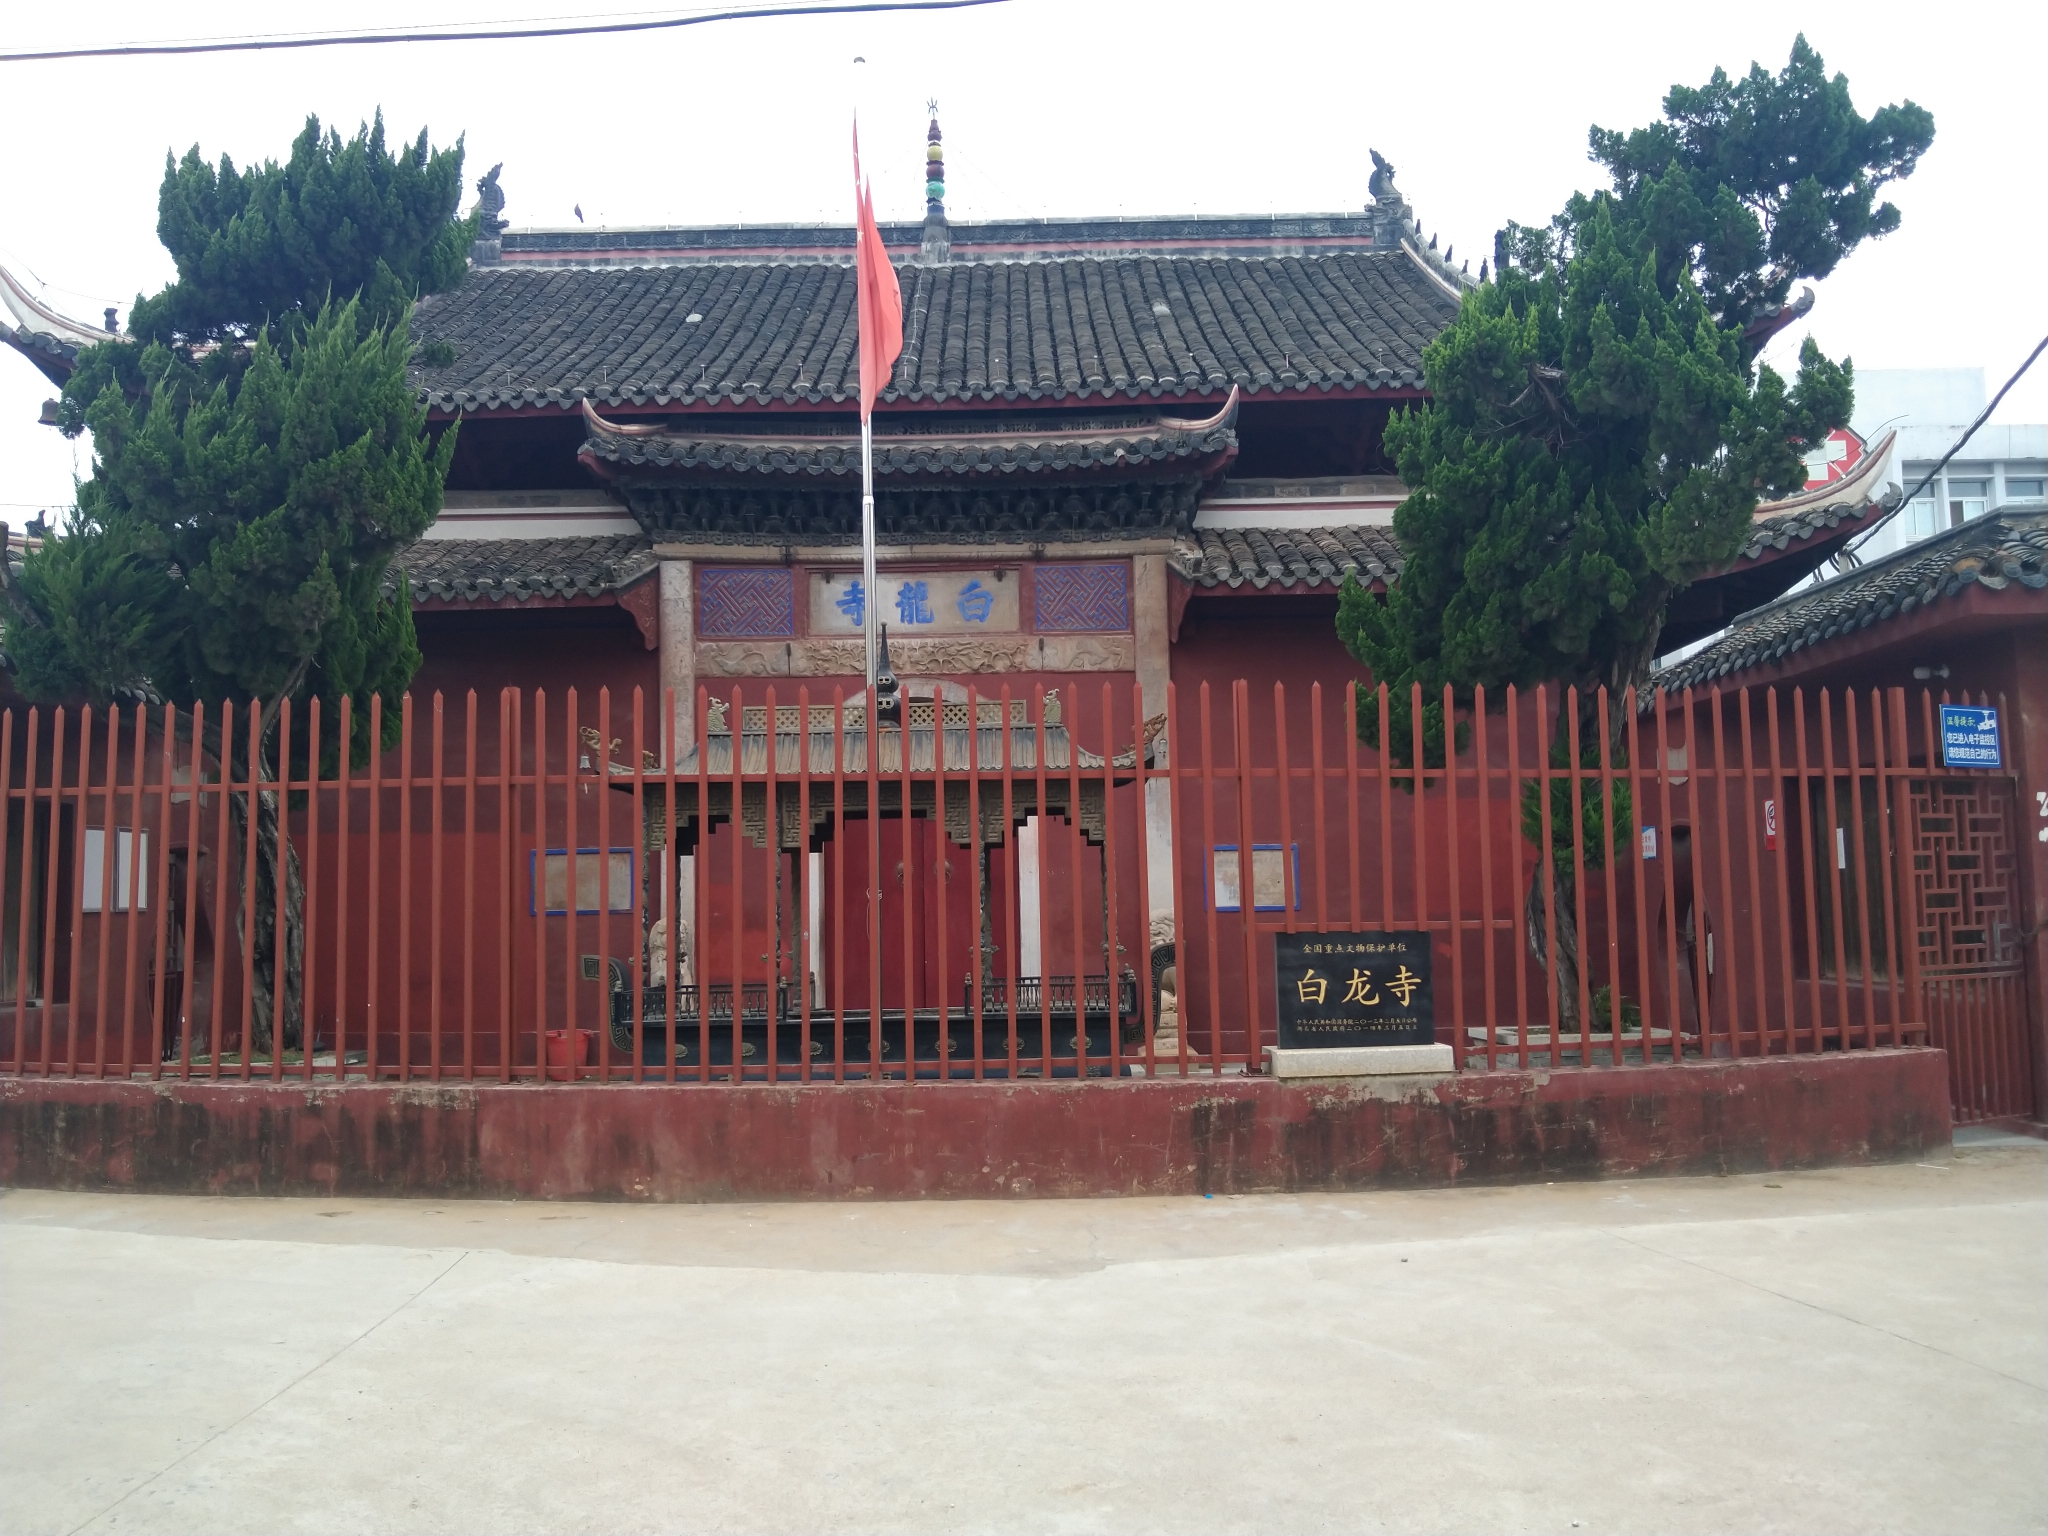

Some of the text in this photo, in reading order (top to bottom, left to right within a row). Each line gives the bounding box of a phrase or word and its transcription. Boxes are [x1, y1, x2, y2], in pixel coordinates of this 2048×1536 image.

[836, 579, 994, 627] 白龍寺
[1947, 732, 1996, 746] 您已进入电子监控区
[1948, 747, 1997, 760] 请您规范自己的行为
[1303, 943, 1407, 954] 全国重点文物保护单位
[1297, 965, 1422, 1007] 白龙寺
